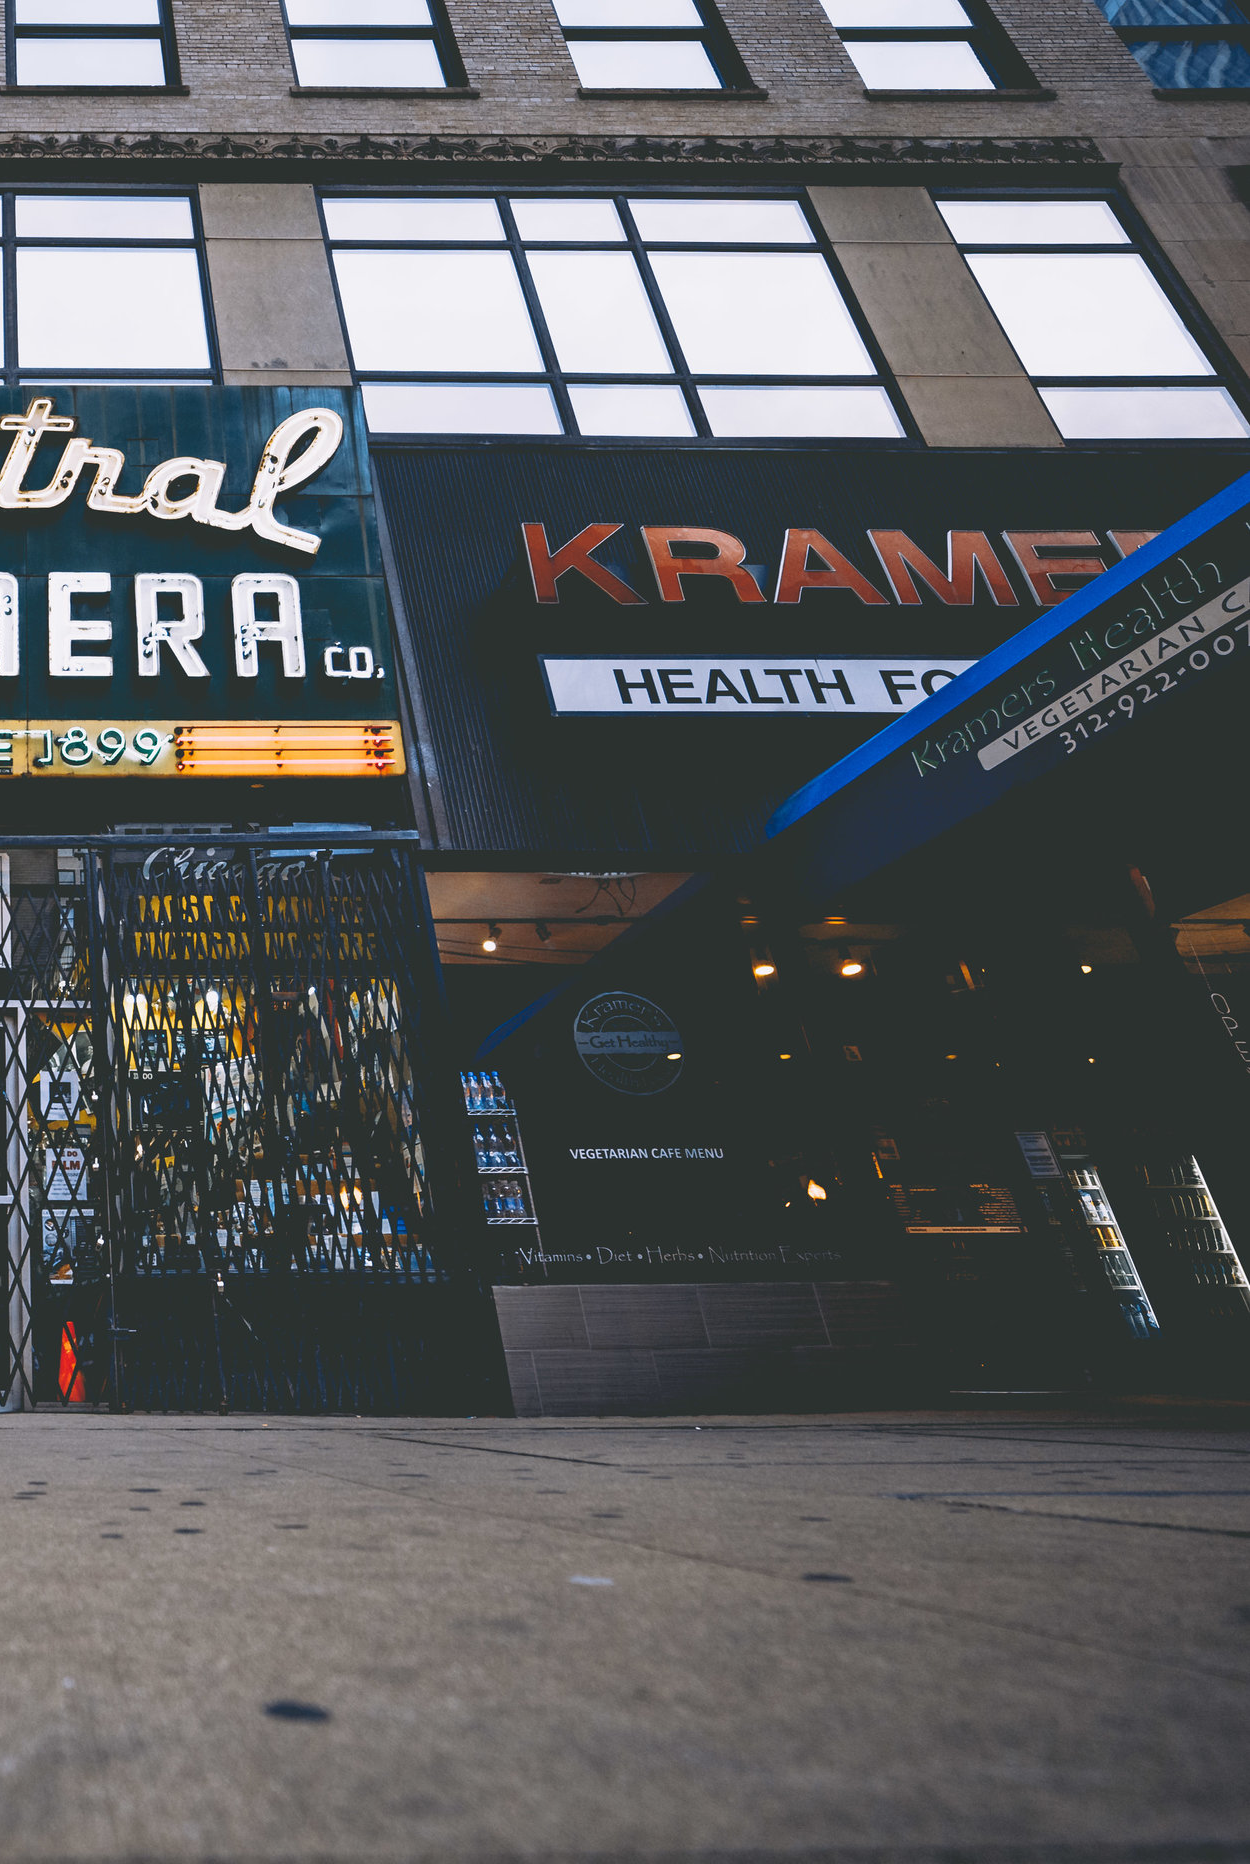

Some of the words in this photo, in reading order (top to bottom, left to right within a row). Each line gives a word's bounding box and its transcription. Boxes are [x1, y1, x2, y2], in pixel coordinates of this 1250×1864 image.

[613, 667, 856, 706] HEALTH
[911, 670, 1056, 777] Kramers
[1069, 557, 1222, 671] Health
[1002, 615, 1206, 751] VEGETARIAN
[35, 726, 172, 768] 1899
[589, 1034, 616, 1049] Get
[617, 1033, 669, 1051] Healthy
[1210, 992, 1250, 1076] OPE
[51, 1160, 81, 1171] FLM
[569, 1148, 649, 1160] VEGETARIAN
[651, 1148, 682, 1159] CAFE
[684, 1148, 724, 1159] MENU
[517, 1247, 583, 1265] Vitamins
[596, 1246, 633, 1265] Diet
[646, 1246, 695, 1265] Herbs
[708, 1245, 776, 1265] Nutrition
